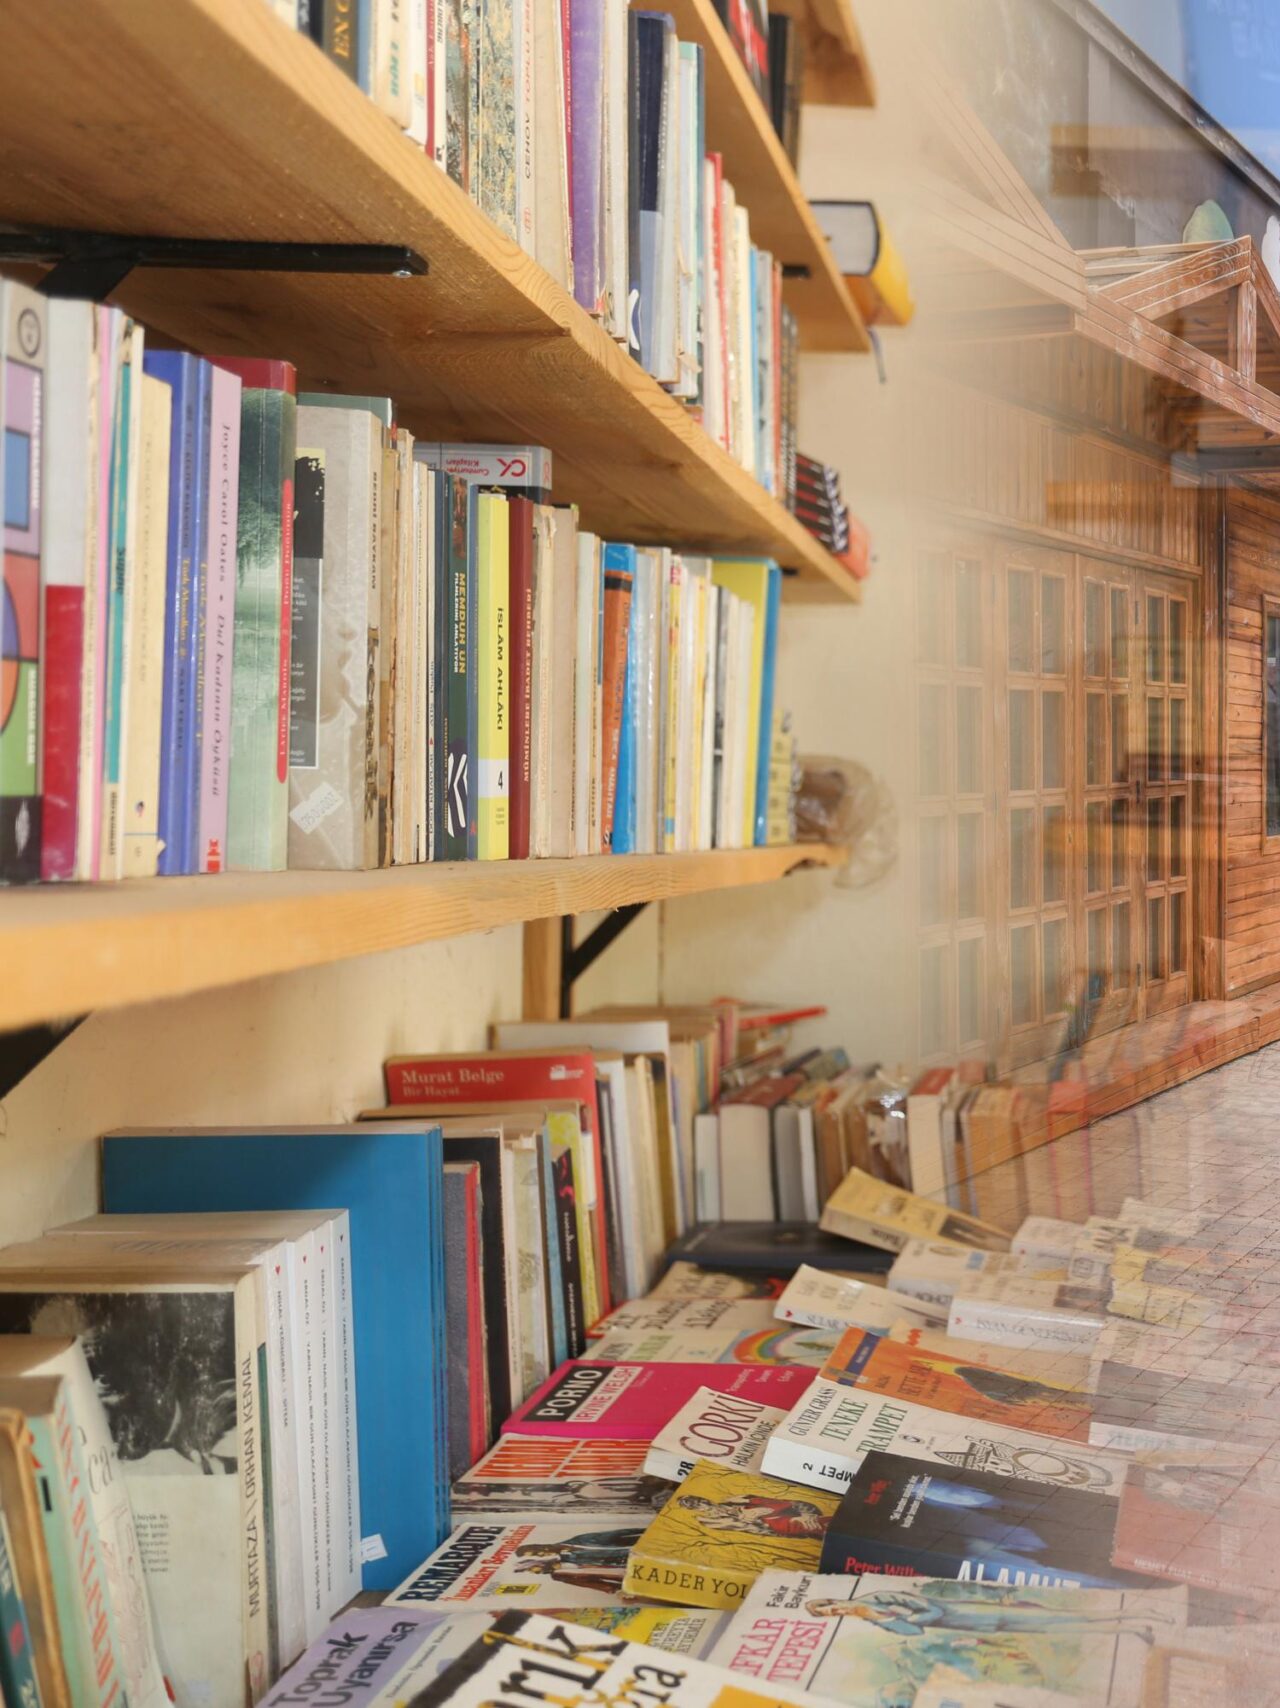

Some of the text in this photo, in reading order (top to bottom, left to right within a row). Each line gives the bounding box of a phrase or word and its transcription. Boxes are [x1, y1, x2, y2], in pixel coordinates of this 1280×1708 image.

[220, 423, 231, 471] Joyce
[221, 478, 230, 526] Carol
[219, 533, 229, 583] Oates
[458, 572, 467, 645] MEMDUH
[498, 769, 504, 790] 4
[402, 1067, 505, 1084] Murat Belge
[403, 1086, 422, 1098] Bir
[536, 1369, 603, 1417] PORNO
[819, 1397, 869, 1442] TENEKE
[856, 1402, 910, 1453] TRAMPET
[241, 1351, 260, 1619] MURTAZA ORHAN KEMAL
[395, 1526, 507, 1602] REMARQUE
[630, 1563, 706, 1592] KADER
[956, 1560, 1082, 1589] ALAM
[272, 1631, 370, 1708] Toprak
